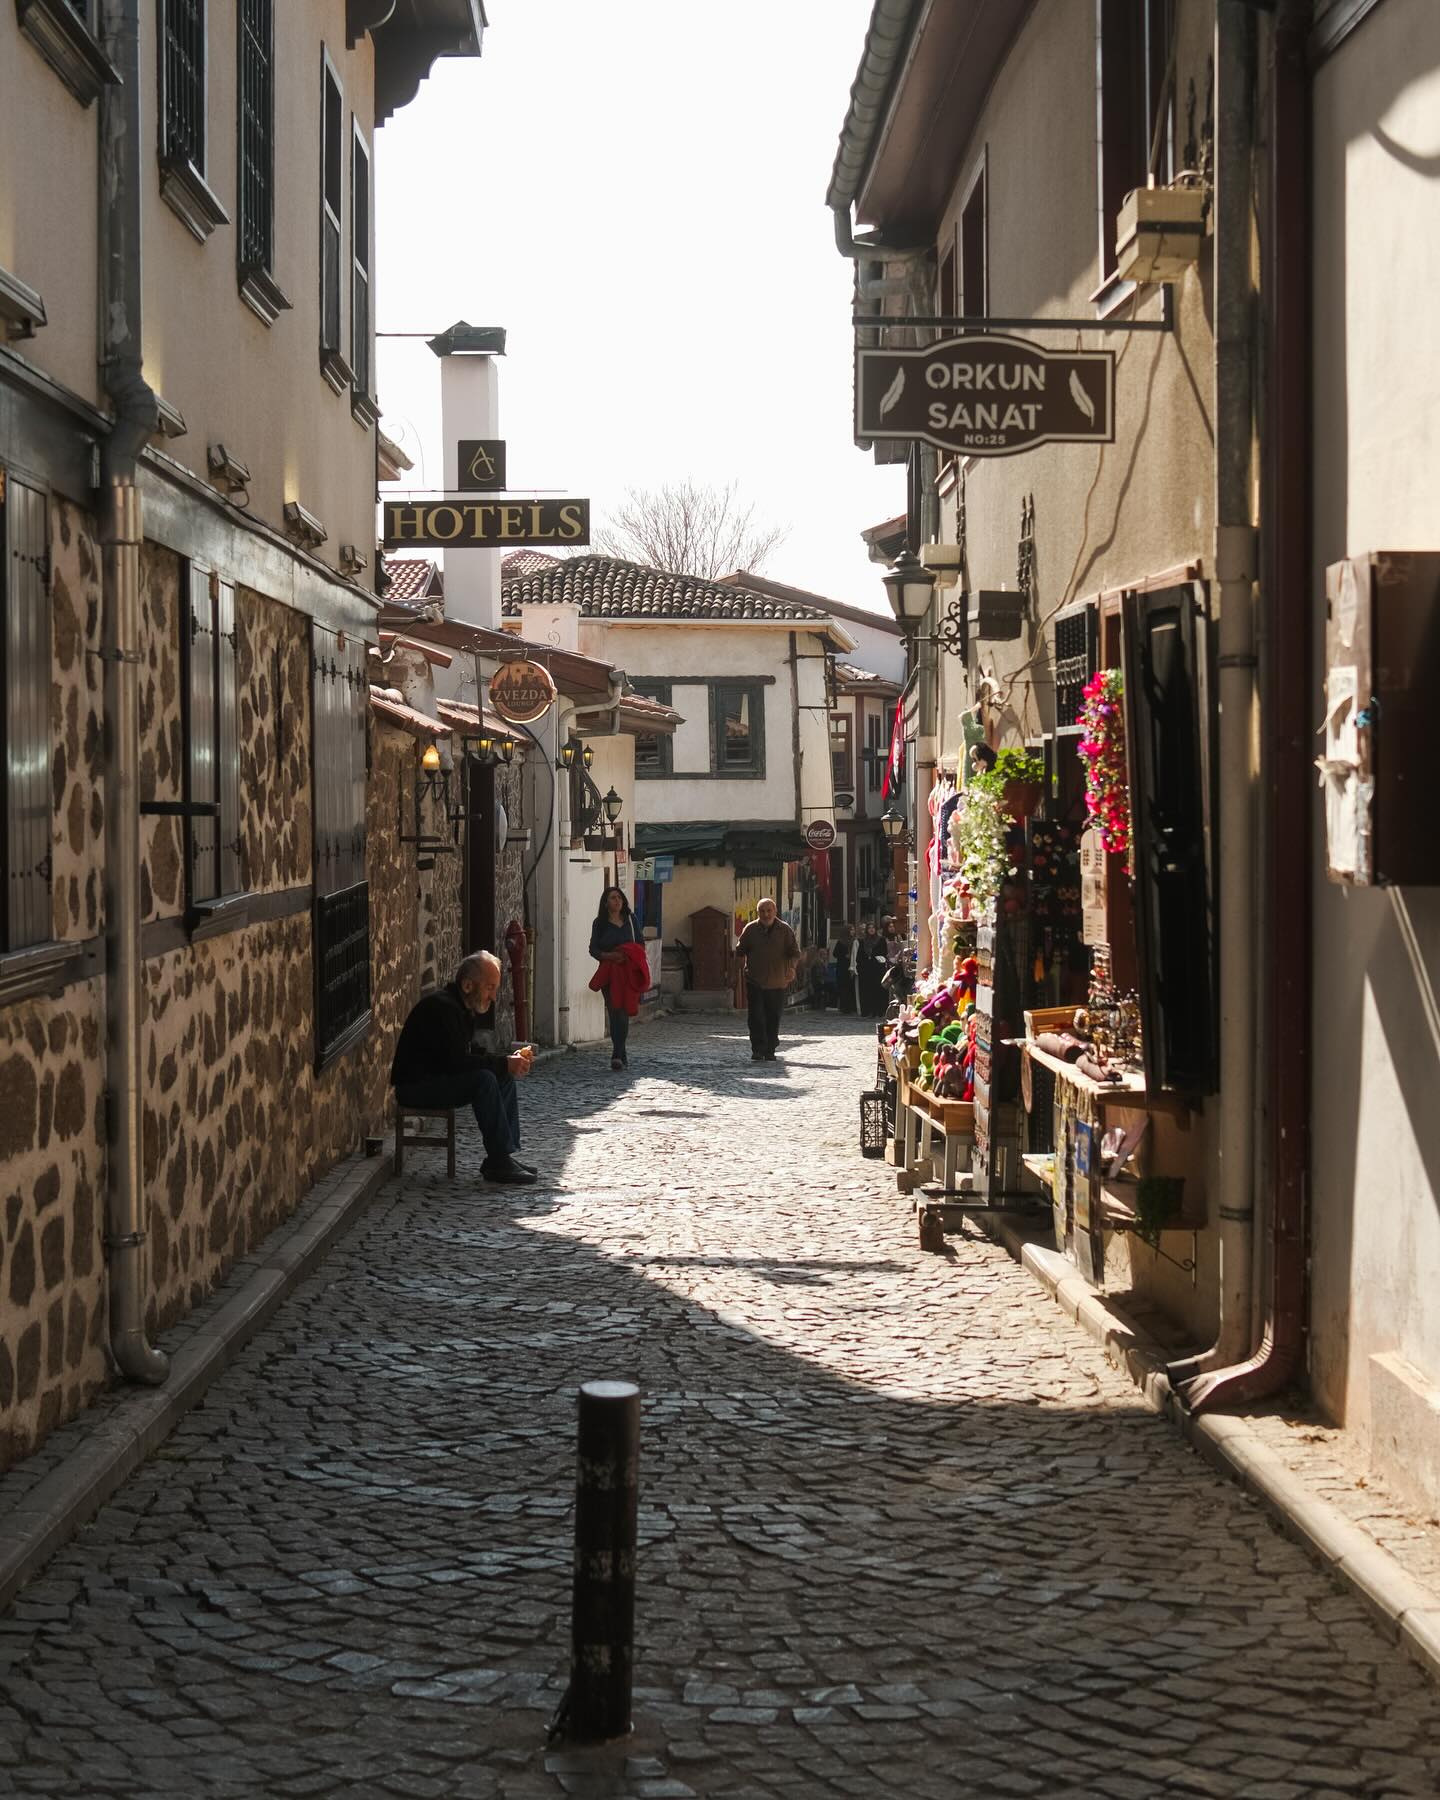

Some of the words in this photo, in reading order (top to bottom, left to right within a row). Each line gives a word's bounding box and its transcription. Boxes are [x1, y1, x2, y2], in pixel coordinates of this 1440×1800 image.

[925, 362, 1046, 391] ORKUN
[927, 402, 1043, 430] SANAT
[964, 433, 1007, 445] NO:25
[389, 505, 584, 540] HOTELS
[495, 689, 548, 701] ZVEZDA
